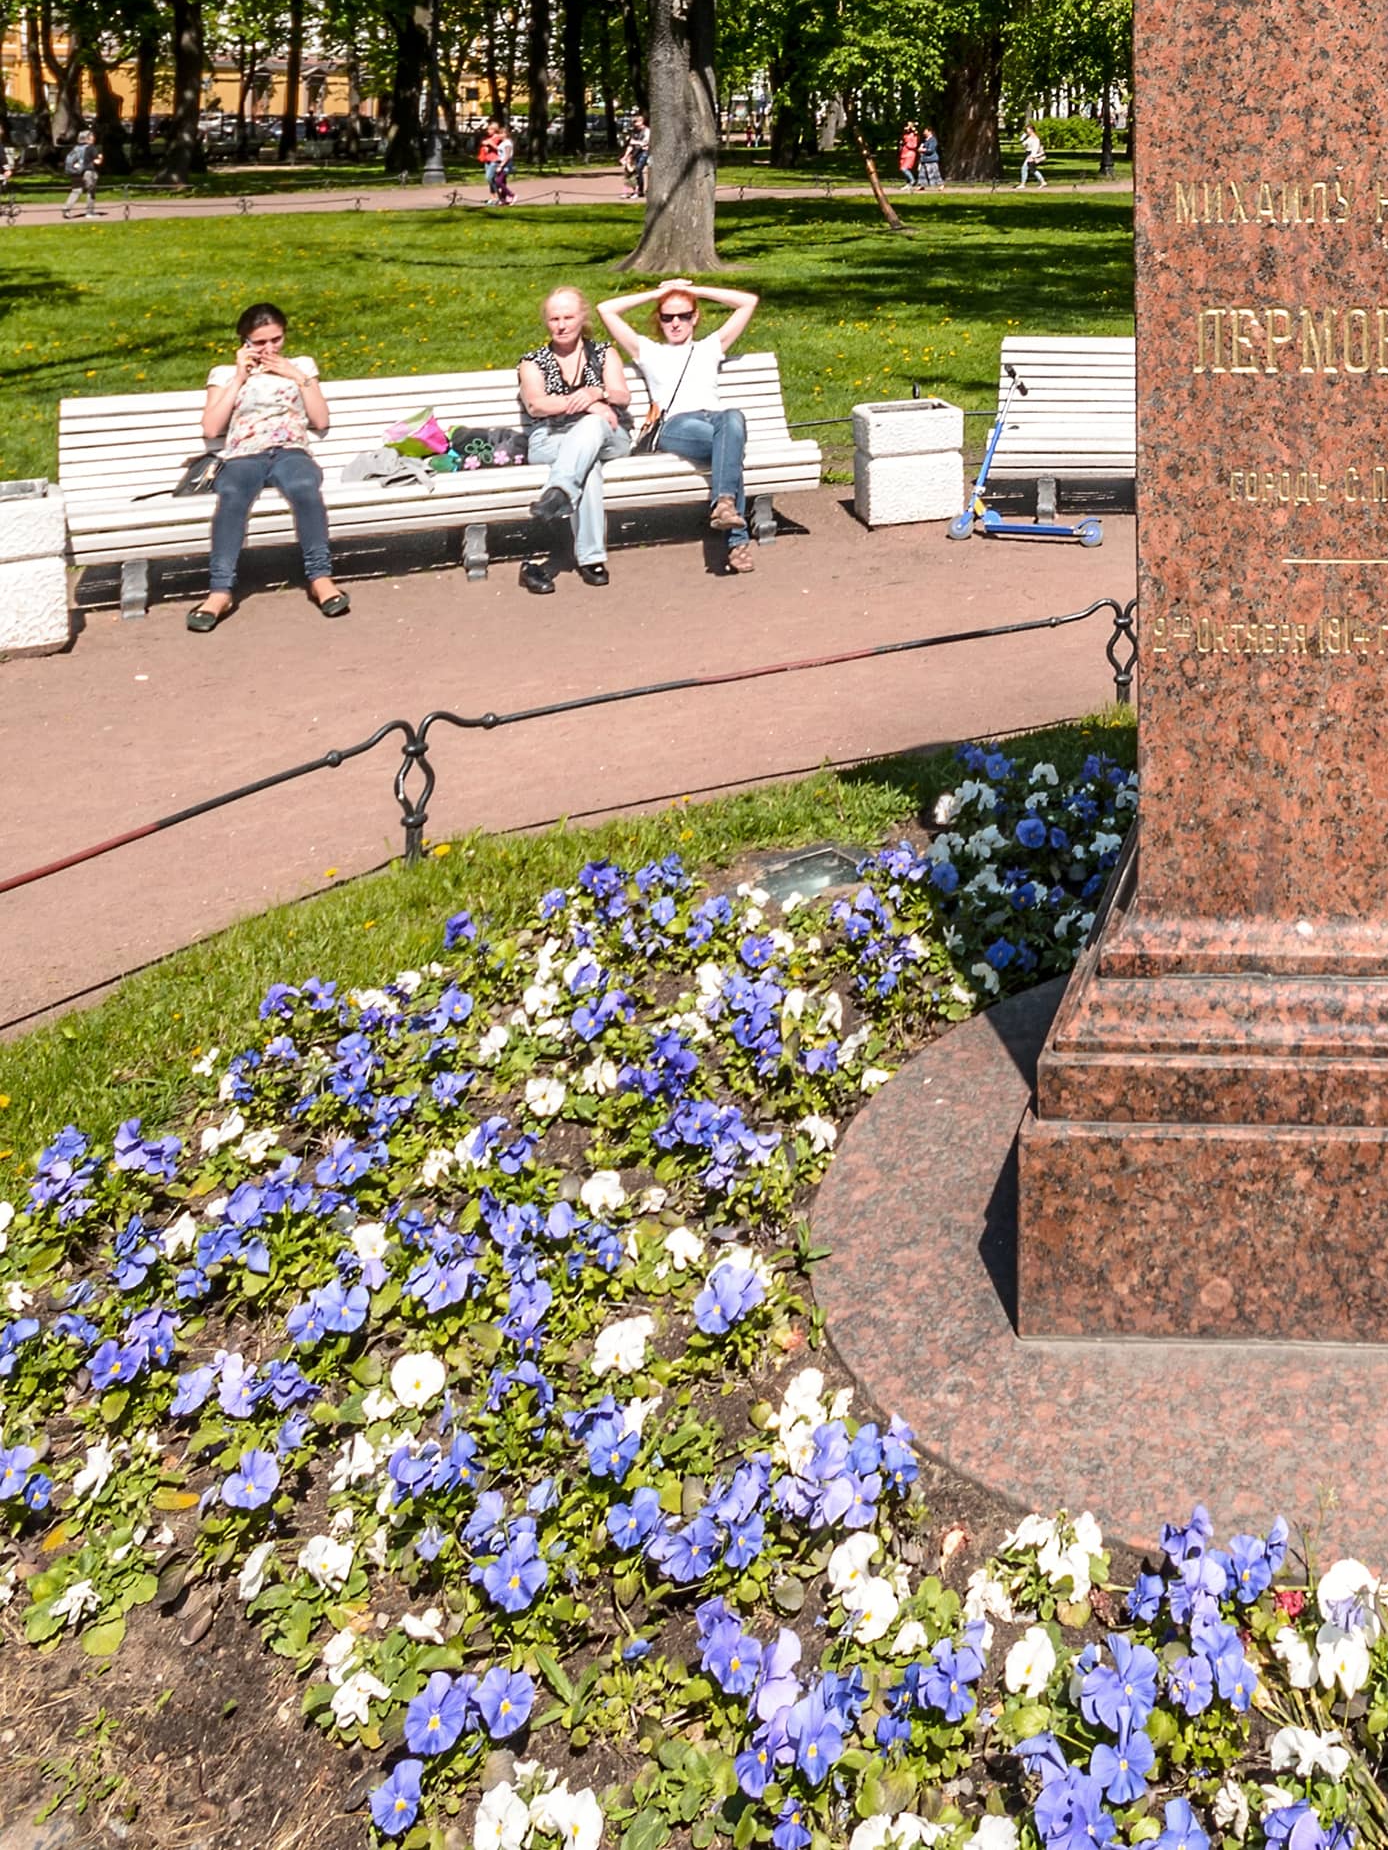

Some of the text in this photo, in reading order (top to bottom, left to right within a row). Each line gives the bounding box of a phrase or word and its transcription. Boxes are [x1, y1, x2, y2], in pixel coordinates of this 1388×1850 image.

[1174, 180, 1354, 224] МИХАИЛУ
[1229, 471, 1329, 507] ГОРОДЪ
[1319, 616, 1370, 654] 1814
